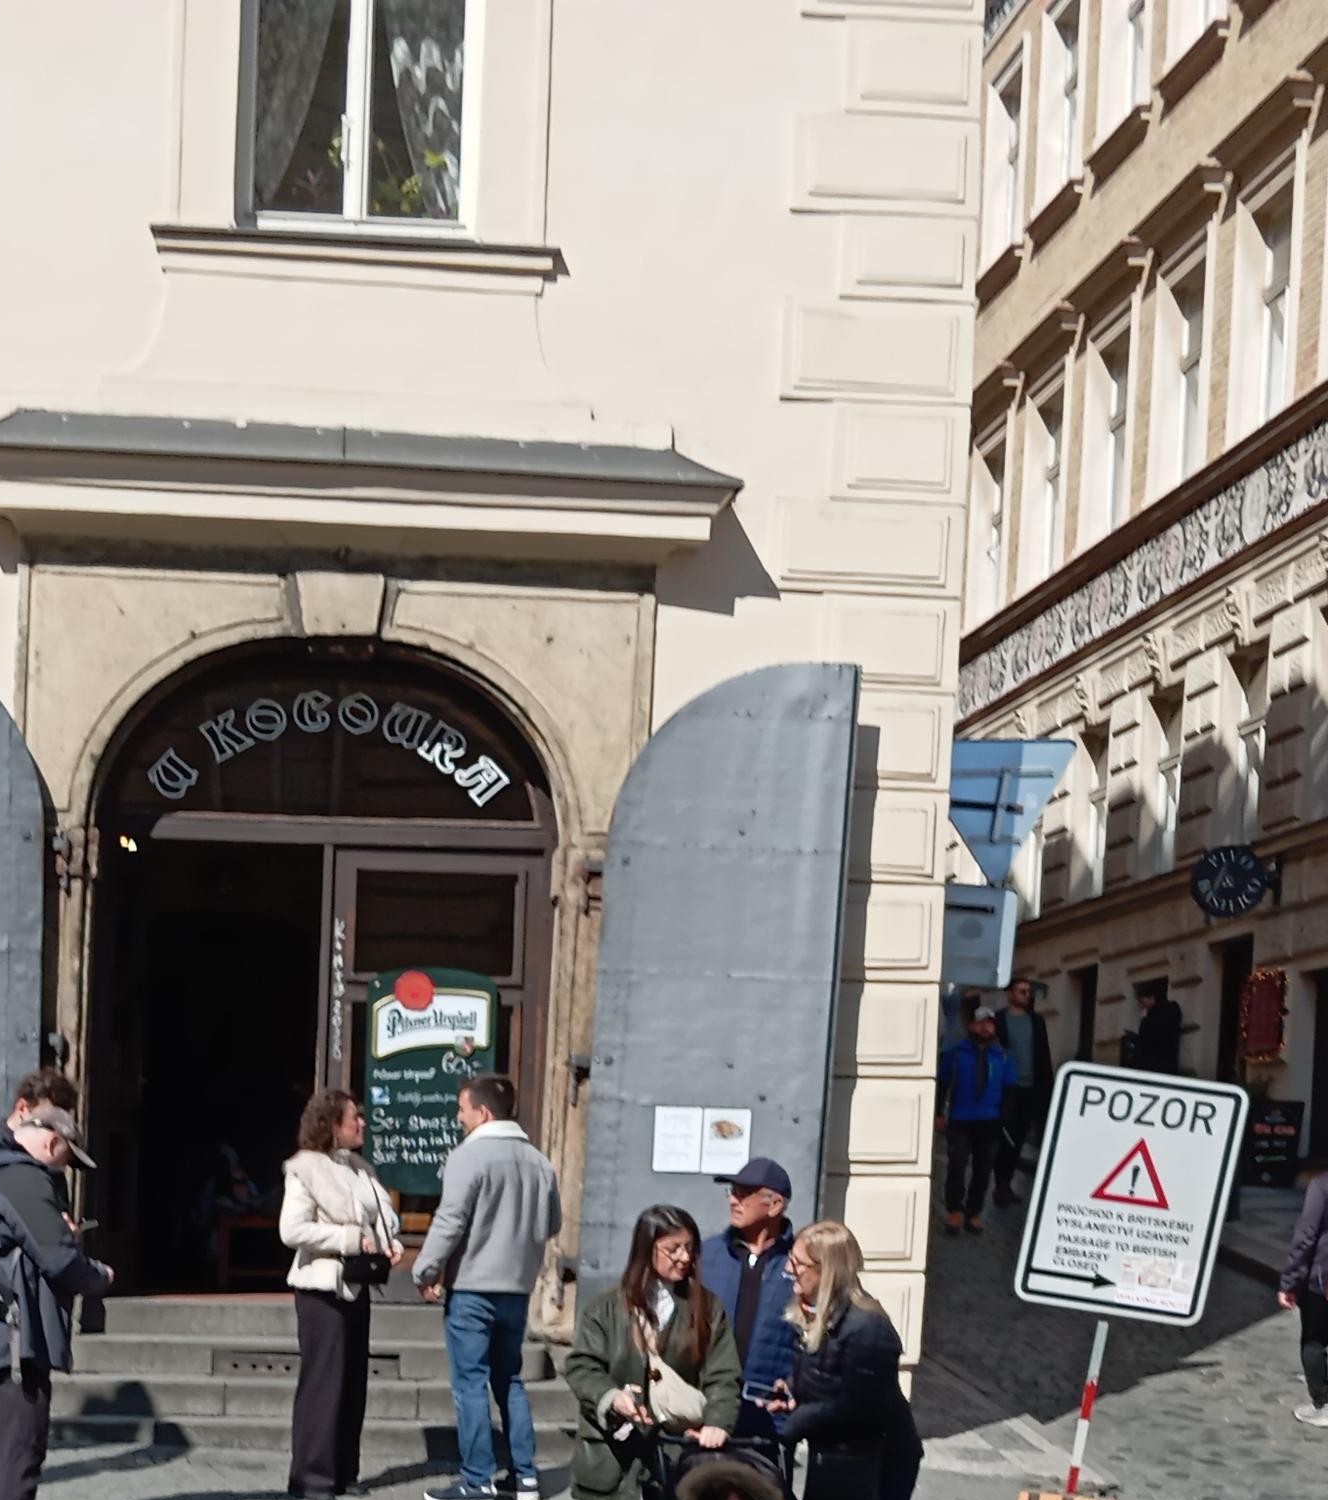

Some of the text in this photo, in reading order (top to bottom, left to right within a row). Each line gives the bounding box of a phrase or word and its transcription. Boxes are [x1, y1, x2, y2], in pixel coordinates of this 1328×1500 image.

[147, 689, 511, 807] U KOCOURA
[432, 1009, 477, 1031] Urquell
[1079, 1085, 1217, 1136] POZOR
[1058, 1232, 1112, 1249] PASSAGE
[1115, 1240, 1130, 1251] TO
